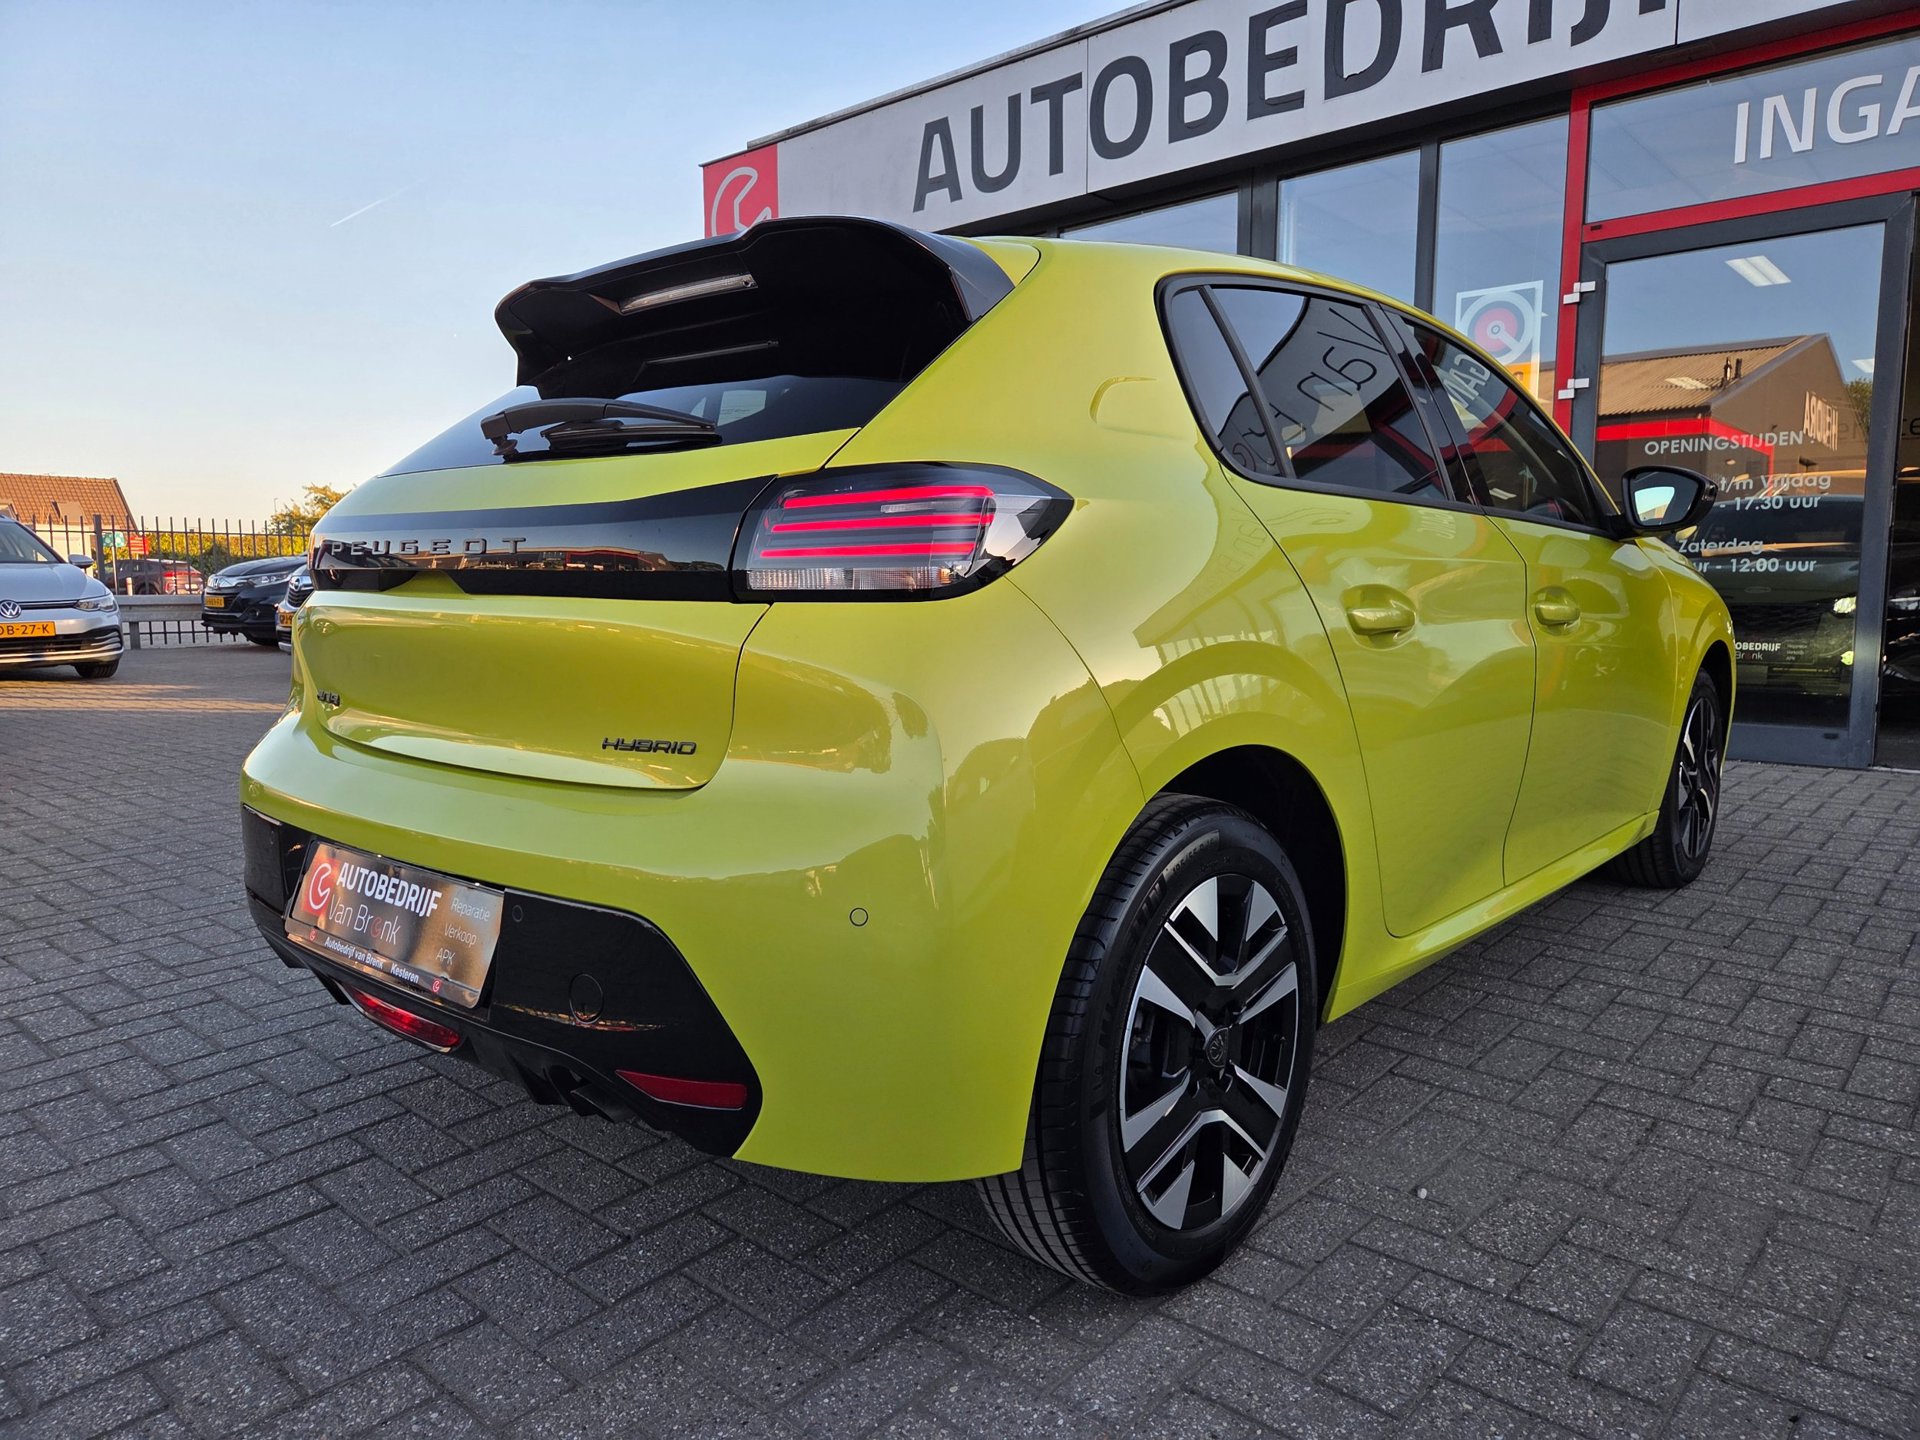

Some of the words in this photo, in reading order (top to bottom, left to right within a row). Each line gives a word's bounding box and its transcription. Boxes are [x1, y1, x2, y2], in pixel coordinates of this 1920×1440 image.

[912, 0, 1666, 212] AUTOBEDR
[1719, 475, 1754, 493] t/m
[1760, 473, 1832, 491] Vrijdag
[1734, 495, 1784, 511] 17.30
[1789, 495, 1822, 509] uur
[331, 537, 526, 556] PEUGEOT
[1678, 538, 1764, 555] Zaterdag
[1693, 561, 1710, 573] ur
[1730, 557, 1780, 573] 12.00
[1785, 559, 1817, 573] uur
[1735, 642, 1782, 652] OBEDRIJF
[602, 737, 697, 756] HYBRID
[336, 861, 443, 918] AUTOBEDRIJF
[328, 893, 353, 928] Van
[451, 896, 491, 923] Reparatie
[443, 922, 478, 946] Verkoop
[324, 936, 356, 960] Autobedrijf
[354, 949, 366, 962] van
[390, 962, 420, 984] Kesteren
[435, 947, 456, 966] APK
